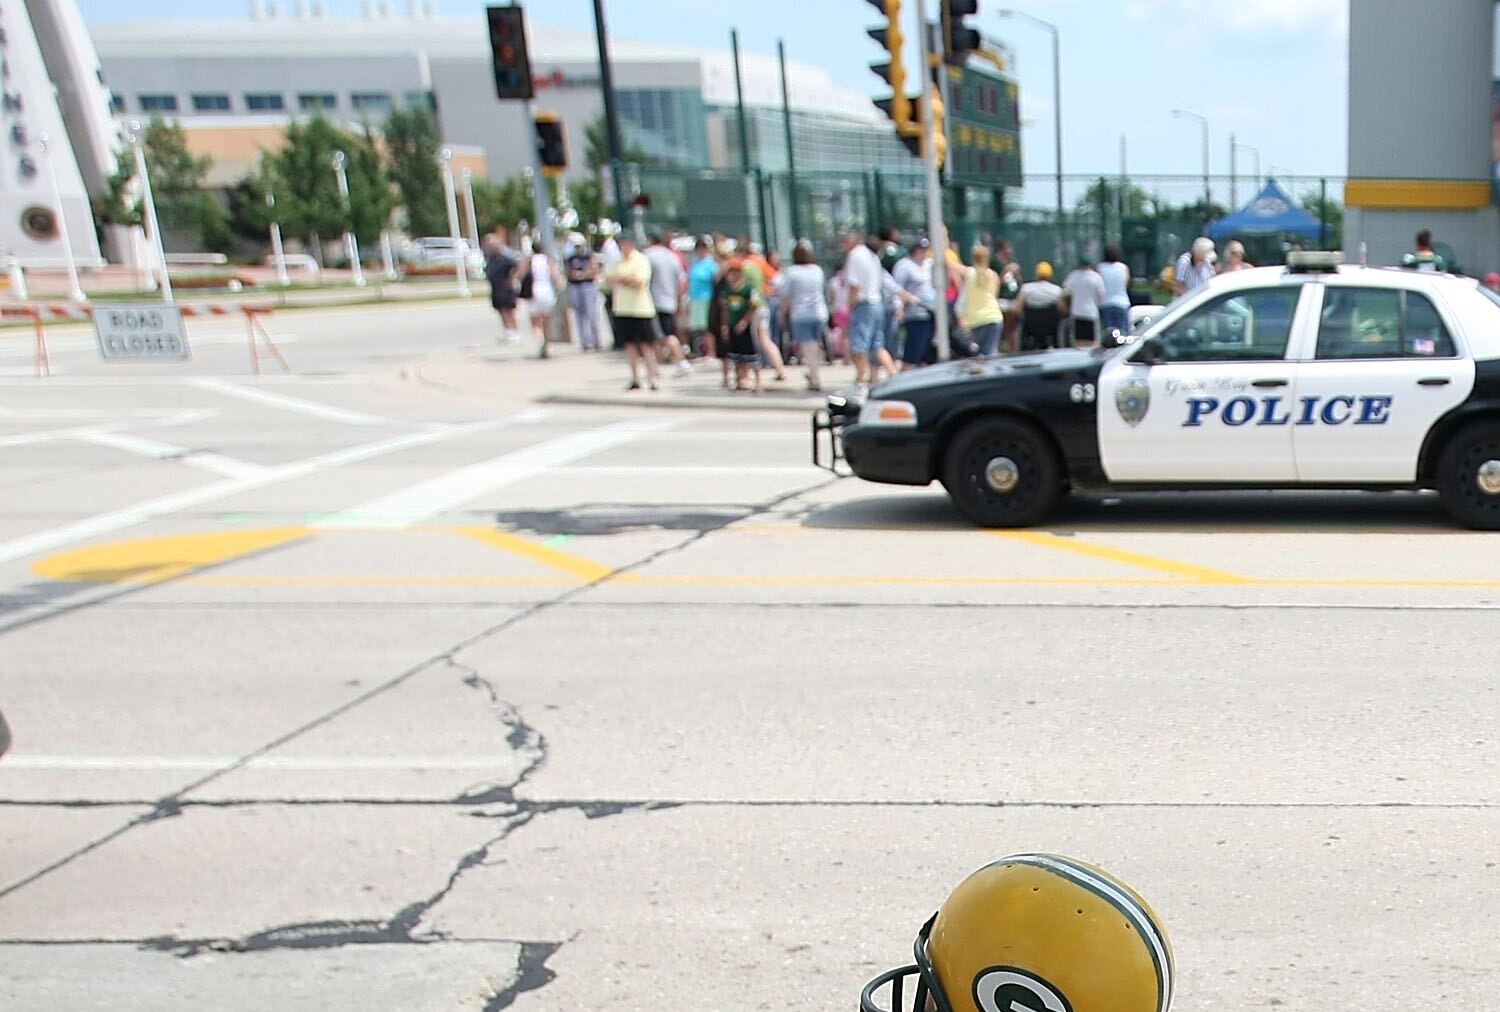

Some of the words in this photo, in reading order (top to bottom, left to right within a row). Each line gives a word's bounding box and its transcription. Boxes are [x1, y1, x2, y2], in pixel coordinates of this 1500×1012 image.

[110, 310, 164, 330] ROAD
[104, 332, 181, 353] CLOSED
[1070, 383, 1096, 403] 63
[1182, 395, 1394, 427] POLICE
